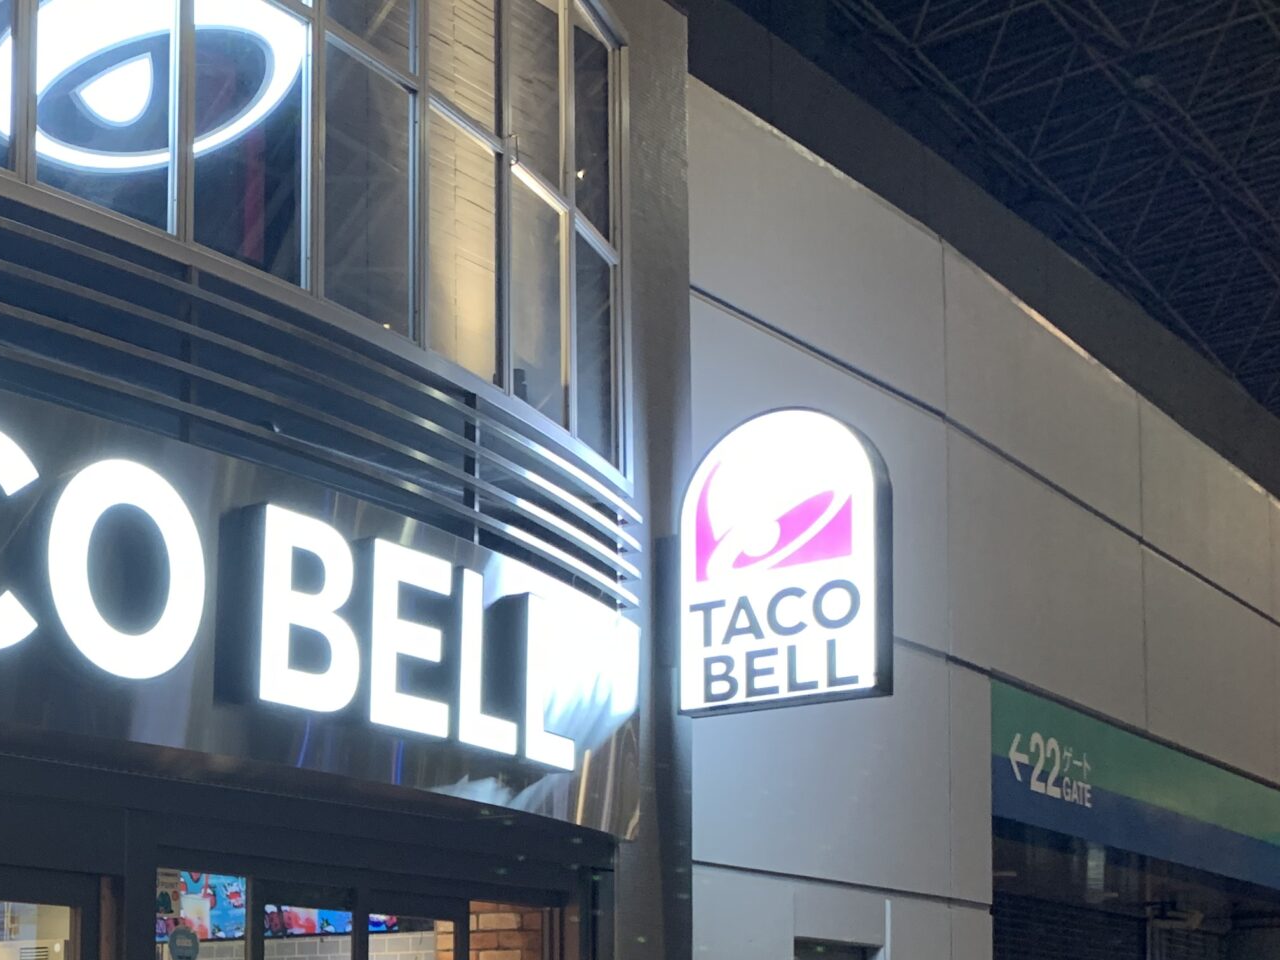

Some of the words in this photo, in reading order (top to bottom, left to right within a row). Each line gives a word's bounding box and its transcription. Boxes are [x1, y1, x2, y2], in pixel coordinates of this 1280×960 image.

[259, 504, 575, 771] BELL
[689, 579, 860, 647] TACO
[704, 639, 859, 703] BELL
[1030, 732, 1061, 798] 22
[1063, 747, 1091, 779] ゲート
[1063, 777, 1092, 808] GATE
